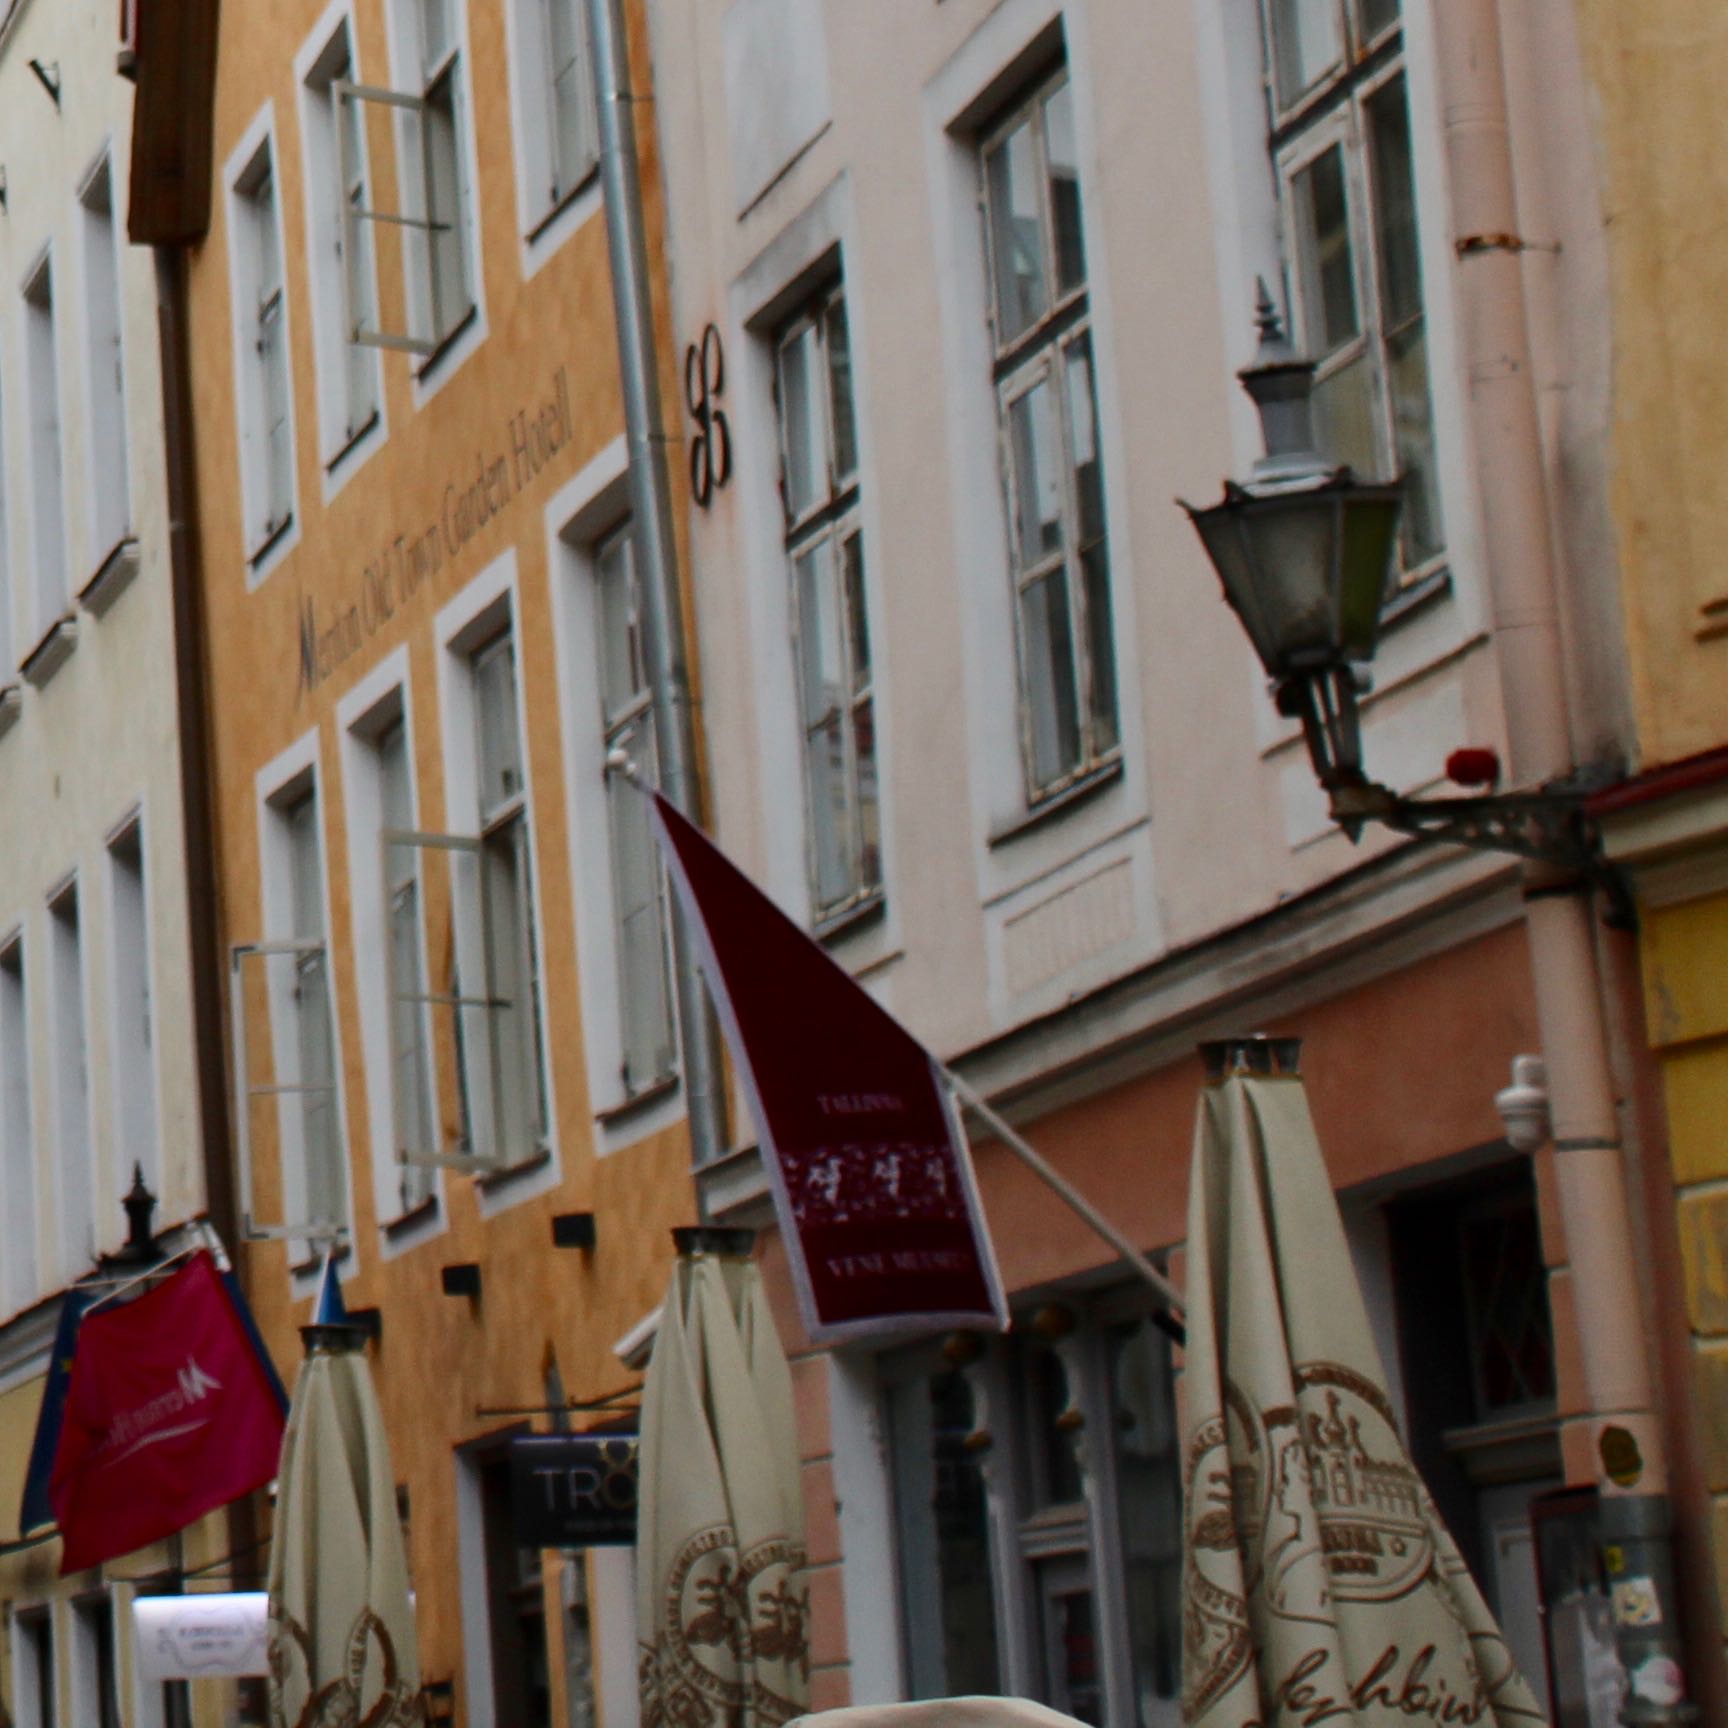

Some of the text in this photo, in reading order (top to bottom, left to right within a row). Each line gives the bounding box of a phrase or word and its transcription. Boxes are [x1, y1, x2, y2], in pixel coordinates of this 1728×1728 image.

[361, 548, 394, 636] Old
[394, 524, 442, 603] Town
[443, 448, 511, 557] Garden
